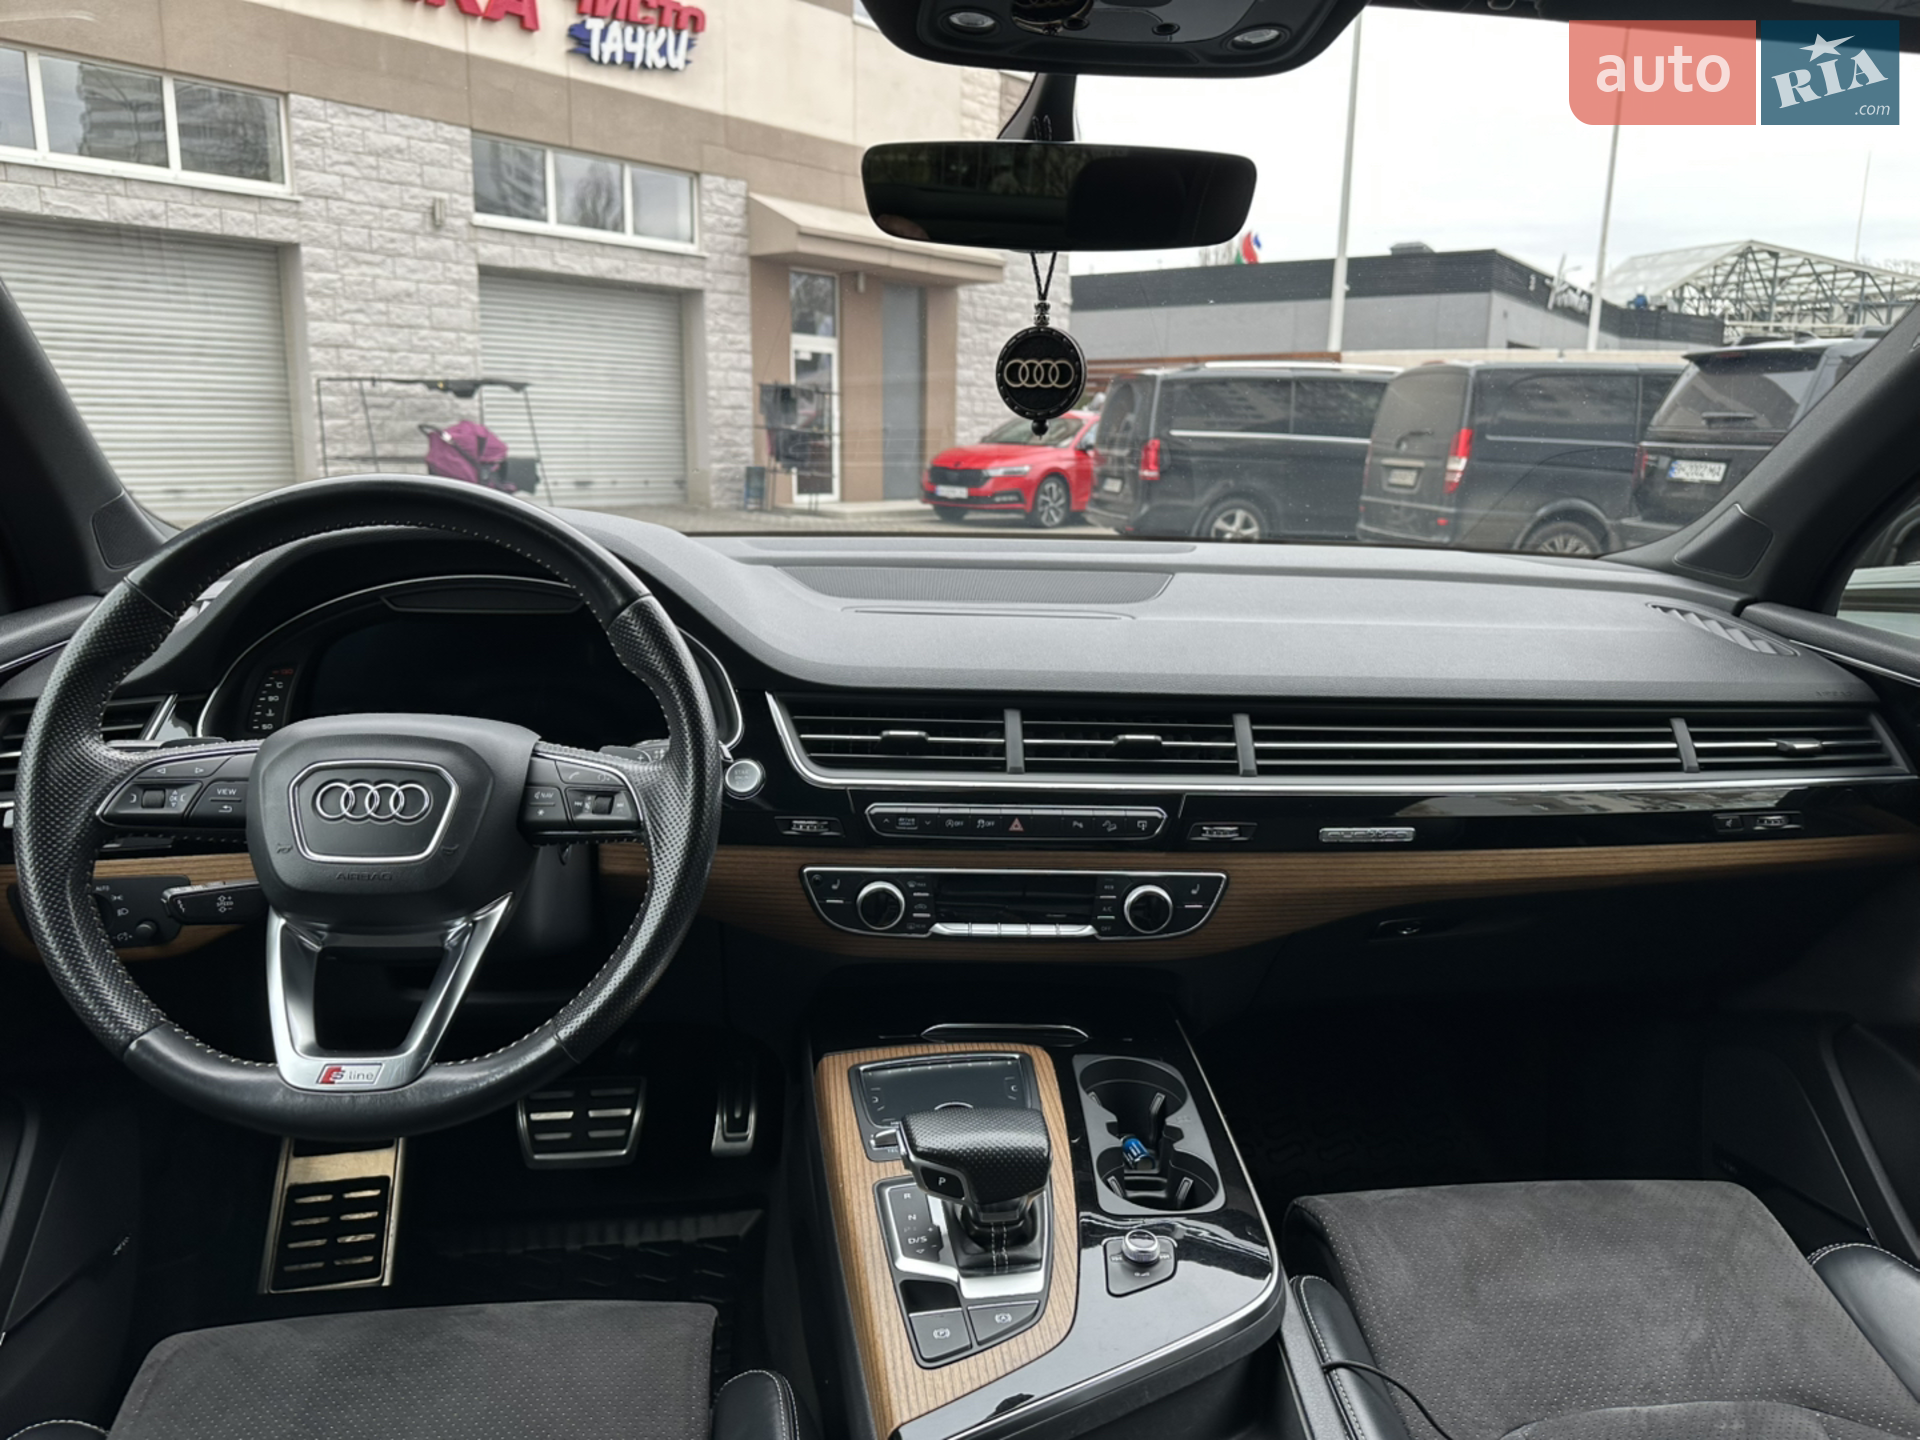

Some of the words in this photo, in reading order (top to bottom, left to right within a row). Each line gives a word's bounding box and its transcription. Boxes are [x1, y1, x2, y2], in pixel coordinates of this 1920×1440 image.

[585, 18, 689, 70] ТАЧКИ
[348, 1070, 374, 1081] line
[938, 1176, 947, 1186] P
[903, 1192, 912, 1200] R
[907, 1235, 928, 1245] D/S
